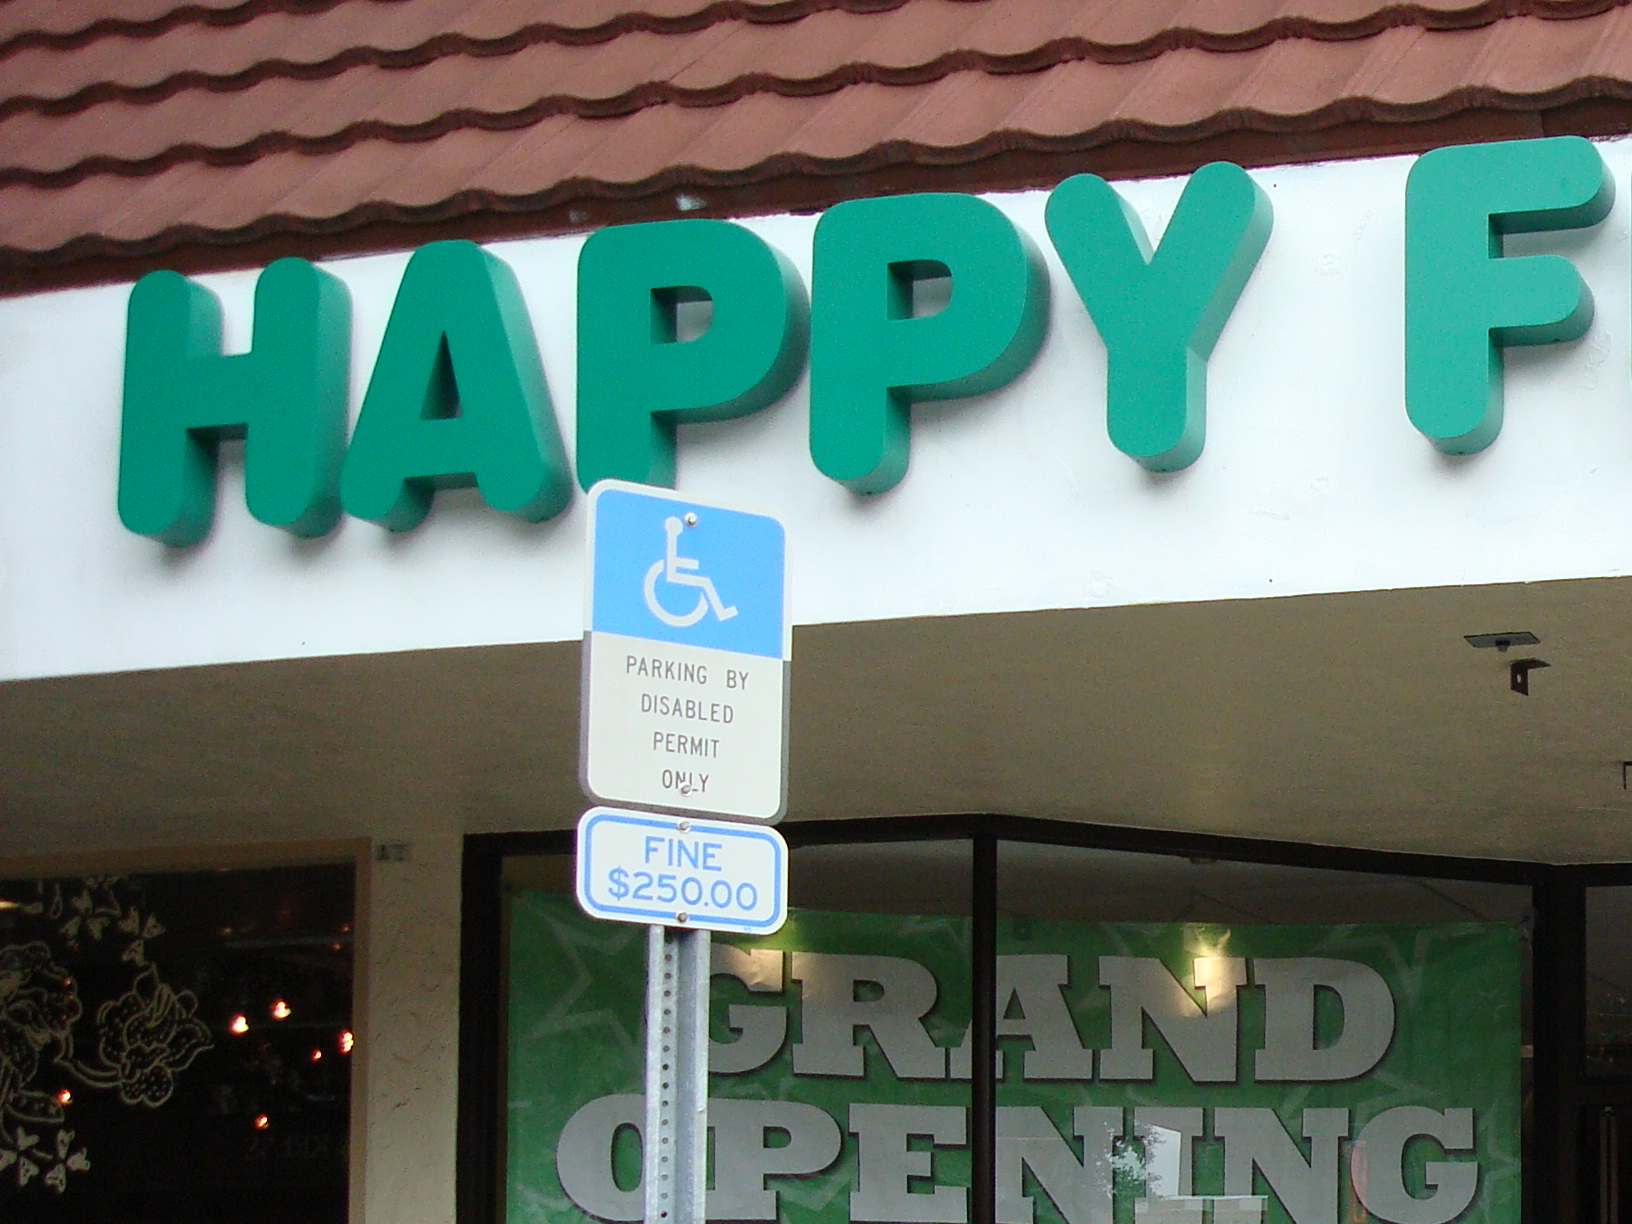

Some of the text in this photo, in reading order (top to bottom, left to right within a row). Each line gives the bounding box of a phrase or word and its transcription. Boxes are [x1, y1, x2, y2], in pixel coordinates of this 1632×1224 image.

[116, 161, 1274, 549] HAPPY
[625, 655, 750, 691] PARKING BY
[640, 693, 735, 724] DISABLED
[652, 731, 720, 759] PERMIT
[661, 769, 711, 794] ONLY
[644, 834, 724, 872] FINE
[607, 865, 759, 912] $250.00
[709, 943, 1397, 1083] GRAND
